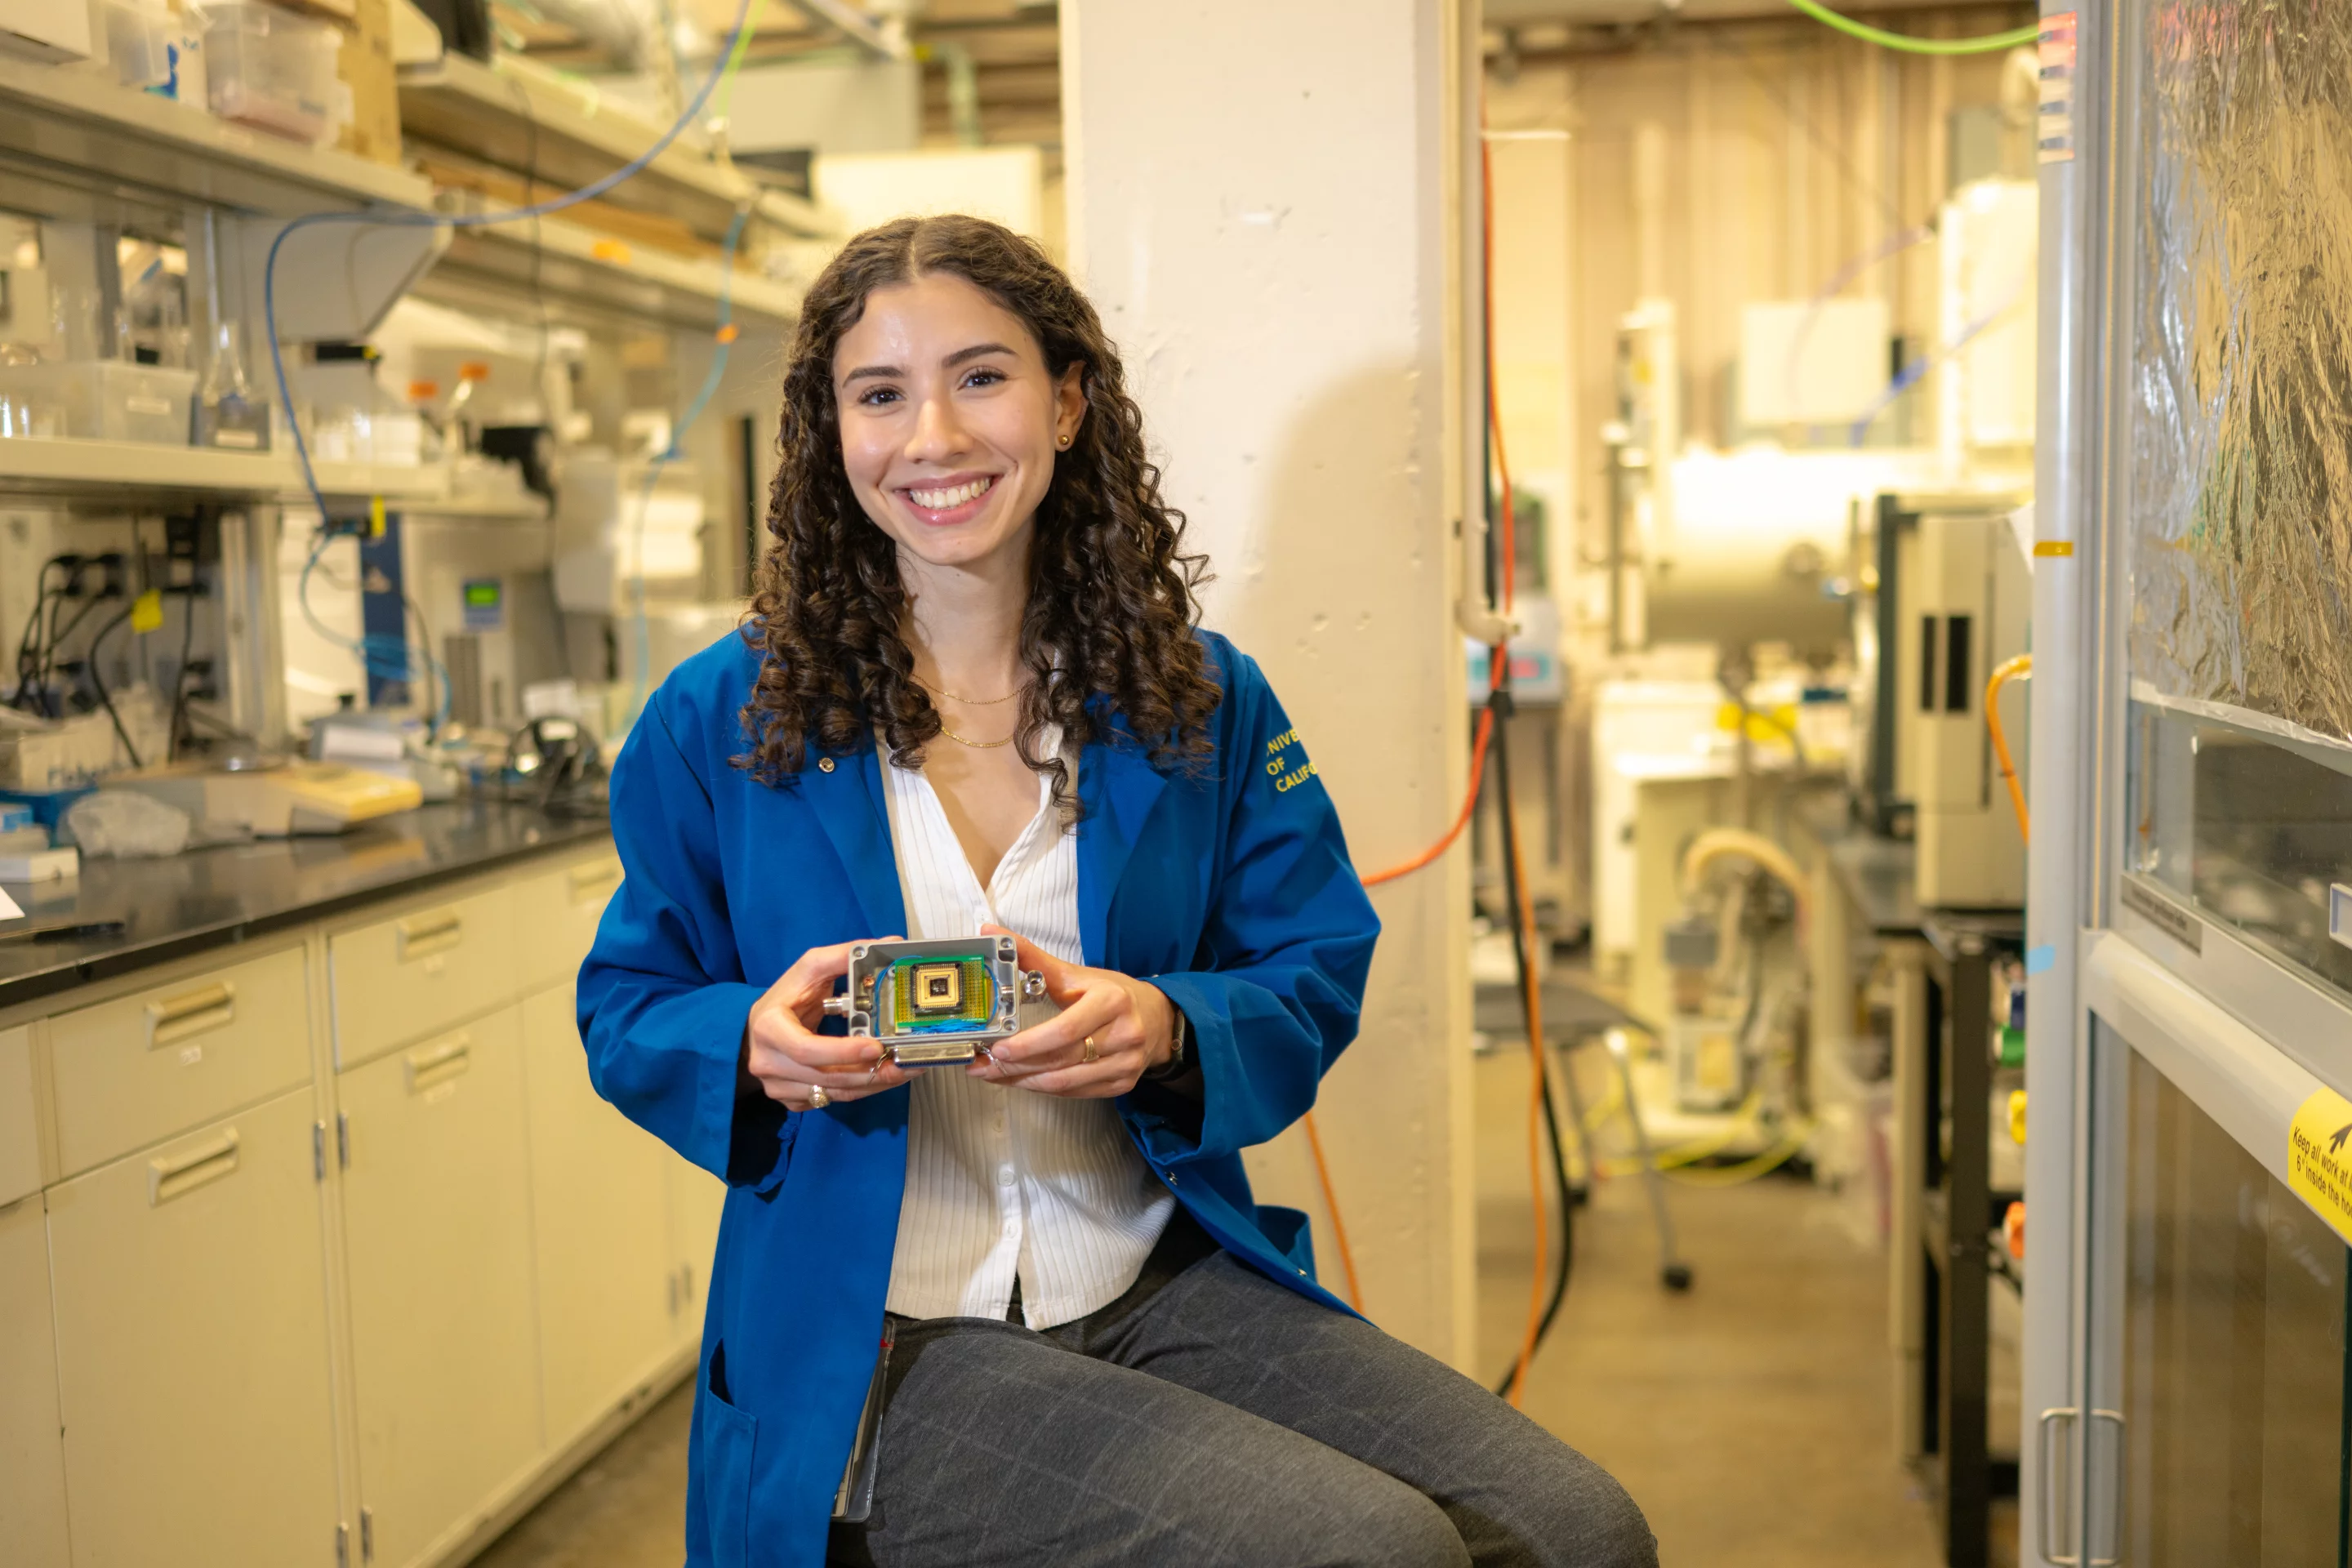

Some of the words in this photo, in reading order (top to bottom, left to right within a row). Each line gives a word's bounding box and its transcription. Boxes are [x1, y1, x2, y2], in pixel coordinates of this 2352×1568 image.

[1267, 728, 1298, 757] NIVE
[1267, 756, 1285, 775] OF
[2292, 1126, 2310, 1158] Keep
[2310, 1144, 2322, 1164] all
[2321, 1153, 2339, 1179] work
[2340, 1169, 2349, 1188] at
[2305, 1160, 2327, 1196] inside
[2328, 1182, 2340, 1206] the
